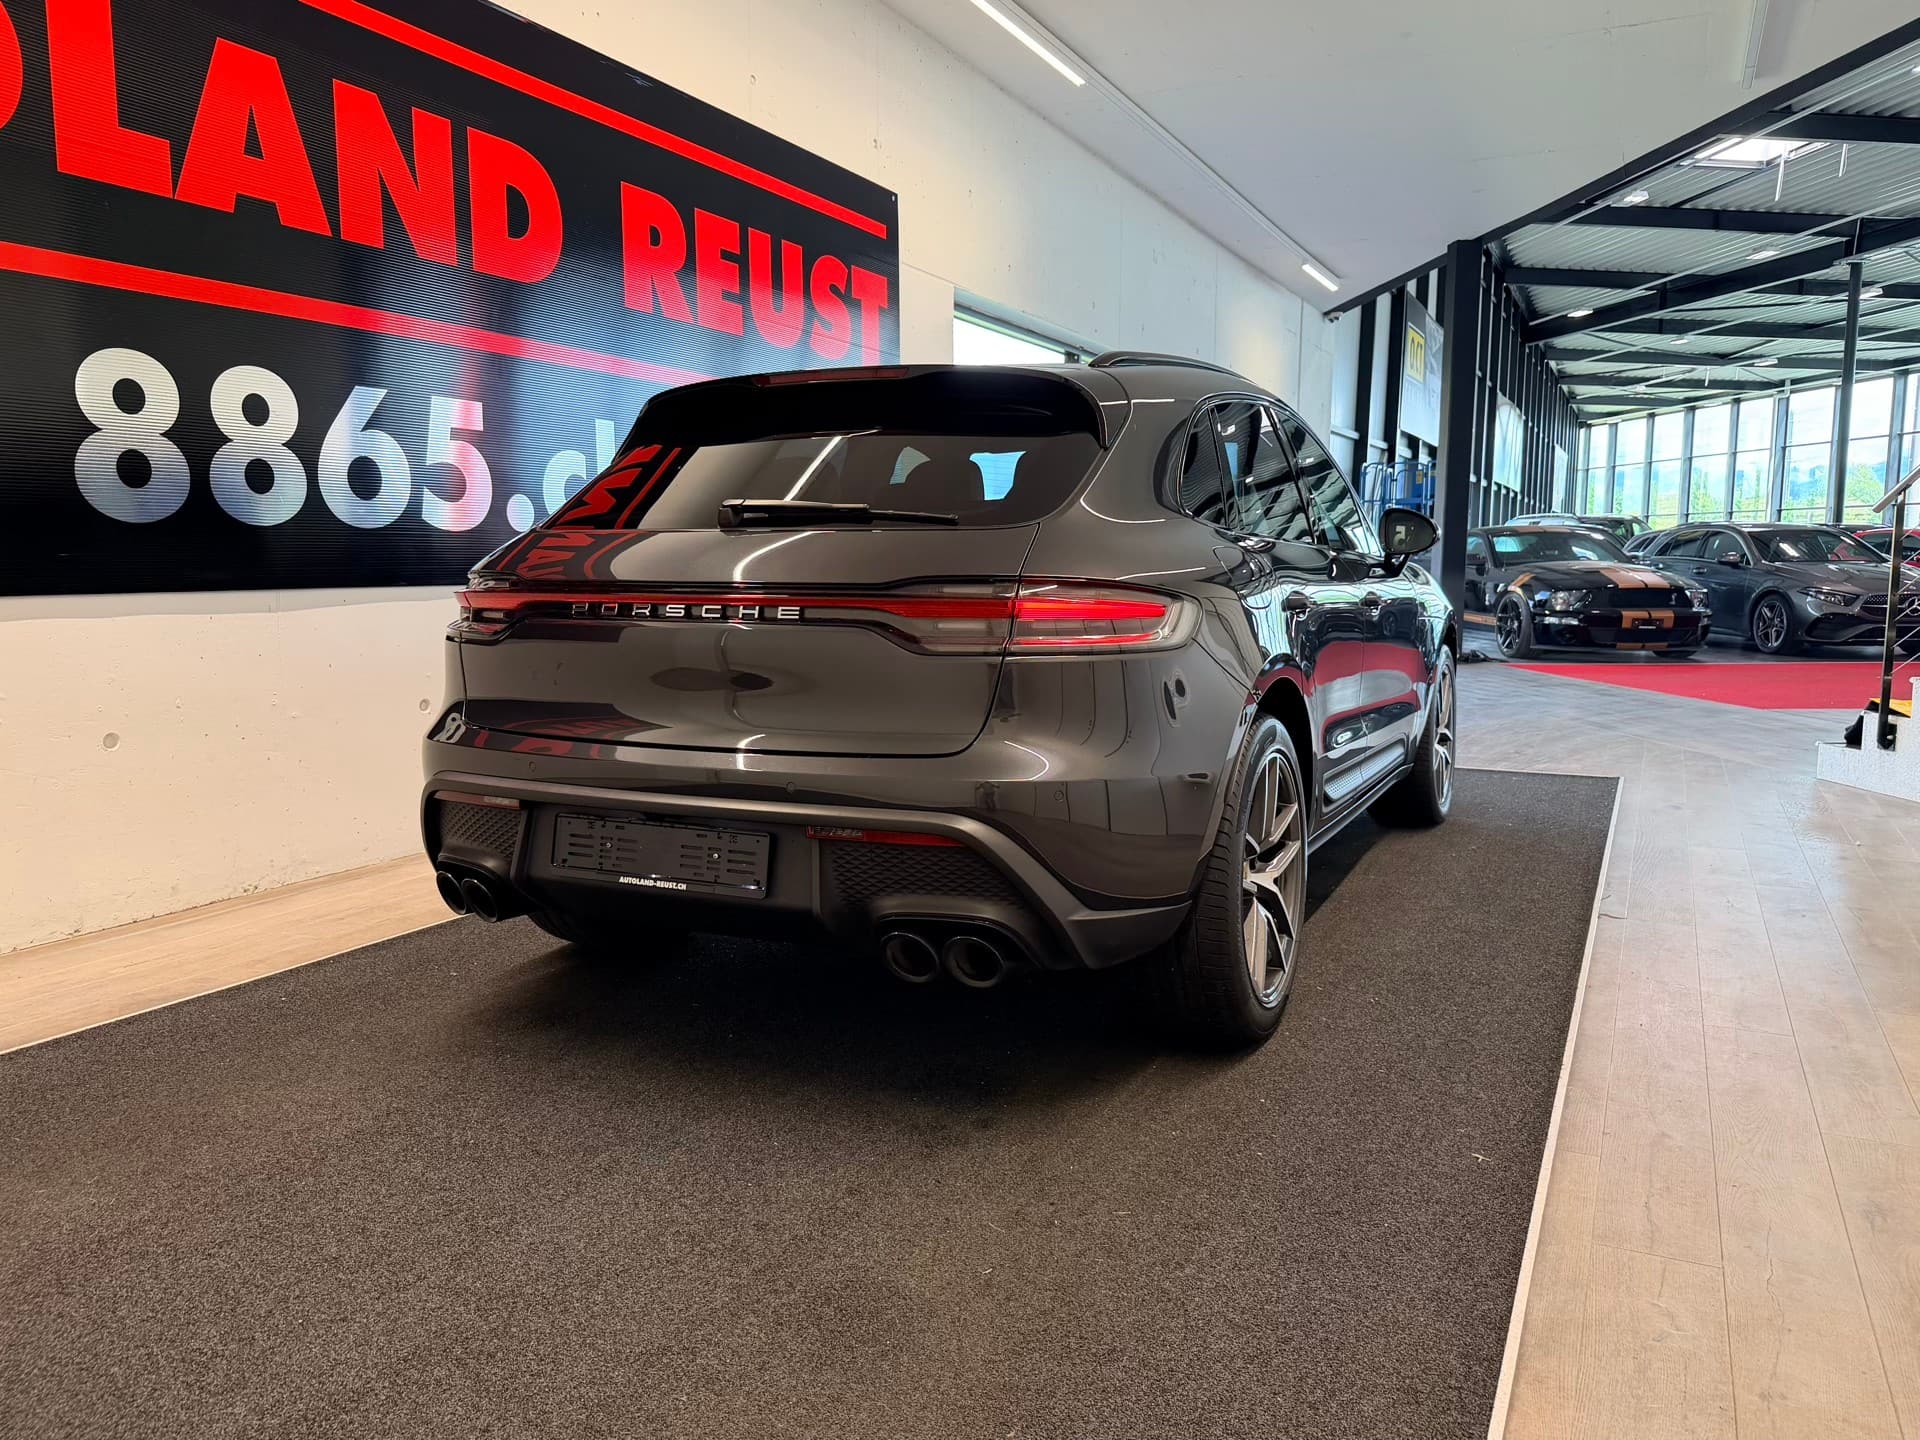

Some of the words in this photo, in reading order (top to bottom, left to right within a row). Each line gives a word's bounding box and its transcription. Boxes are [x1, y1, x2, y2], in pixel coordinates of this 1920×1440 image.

[0, 0, 563, 284] LAND
[621, 181, 888, 367] REUST
[572, 602, 801, 619] PORSCHE
[618, 875, 687, 891] AUTOLAND-REUST.CH
